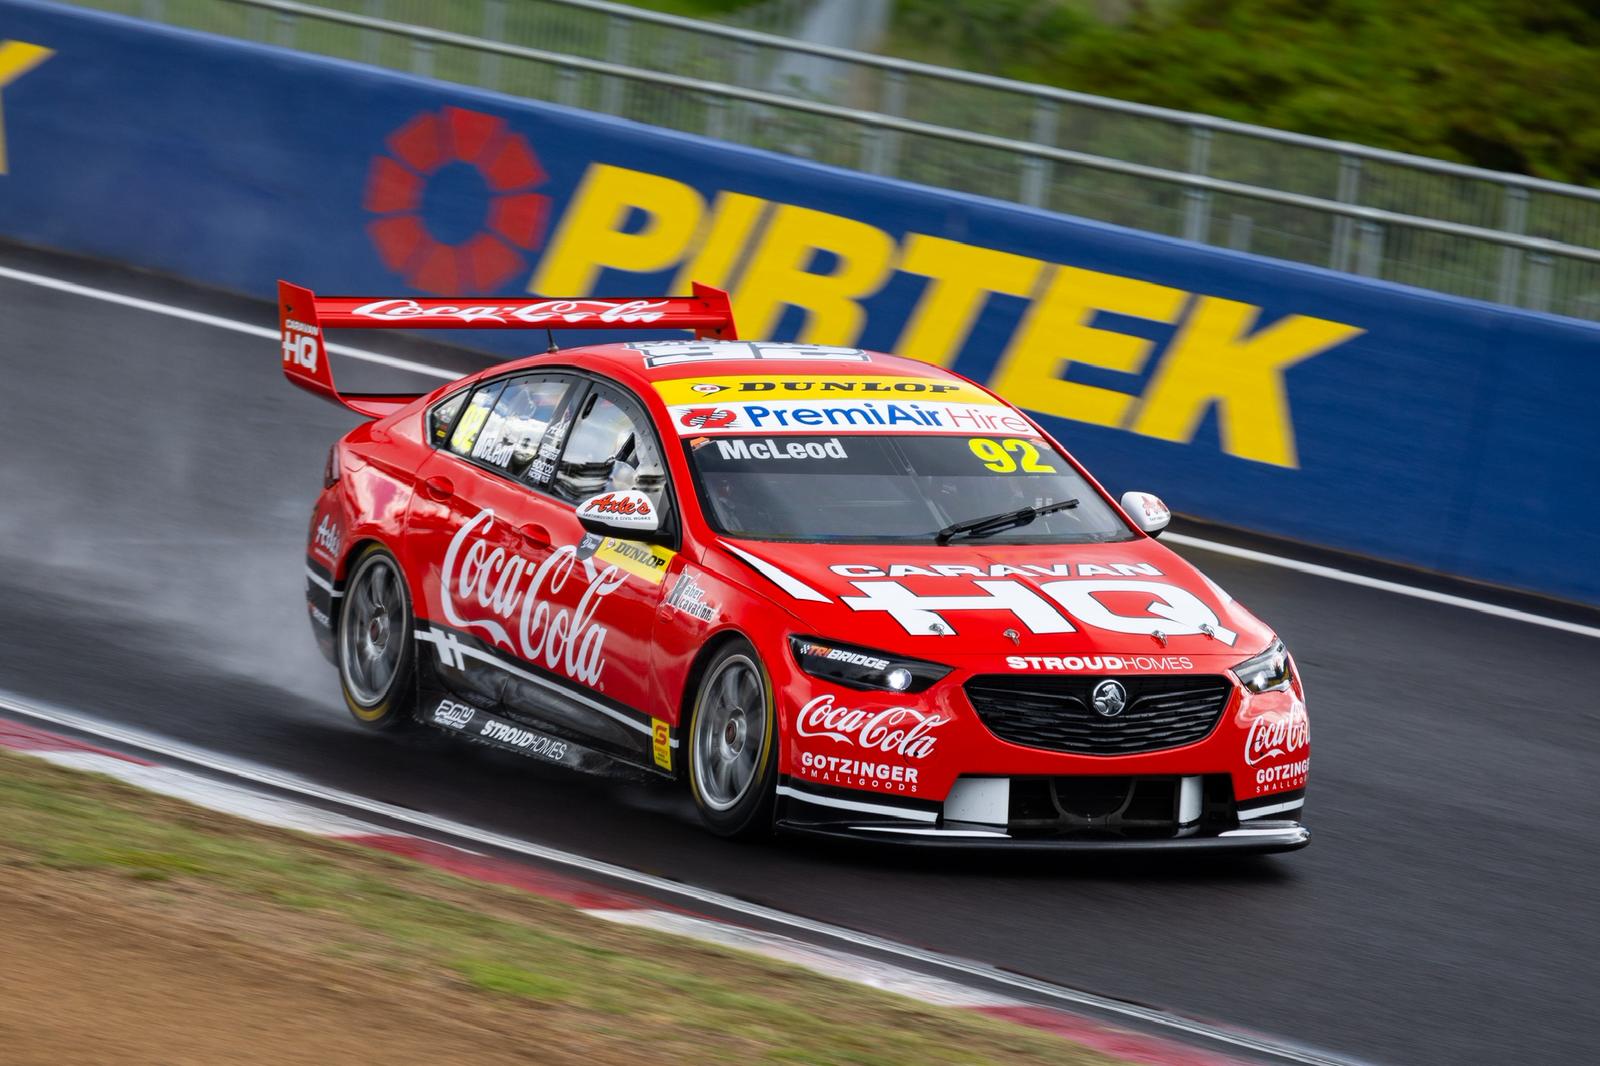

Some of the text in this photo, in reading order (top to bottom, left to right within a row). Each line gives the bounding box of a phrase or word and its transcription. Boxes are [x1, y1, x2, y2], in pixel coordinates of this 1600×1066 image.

[352, 299, 669, 323] Coca-Cola
[525, 161, 1368, 471] PIRTEK
[282, 330, 317, 374] HQ
[738, 380, 961, 395] DUNLOP
[743, 402, 1029, 433] PremiAir Hire
[715, 437, 849, 462] McLeod
[968, 438, 1057, 474] 92
[584, 493, 651, 516] Axle's
[614, 542, 666, 569] DUNLOP
[828, 562, 1164, 578] CARAVAN
[441, 508, 632, 688] Coca-Cola
[838, 579, 1239, 647] HQ
[807, 644, 890, 671] TRIBRIDGE
[796, 694, 952, 759] Coca-Cola
[801, 751, 919, 784] GOTZINGER
[801, 766, 918, 793] SMALLGOODS
